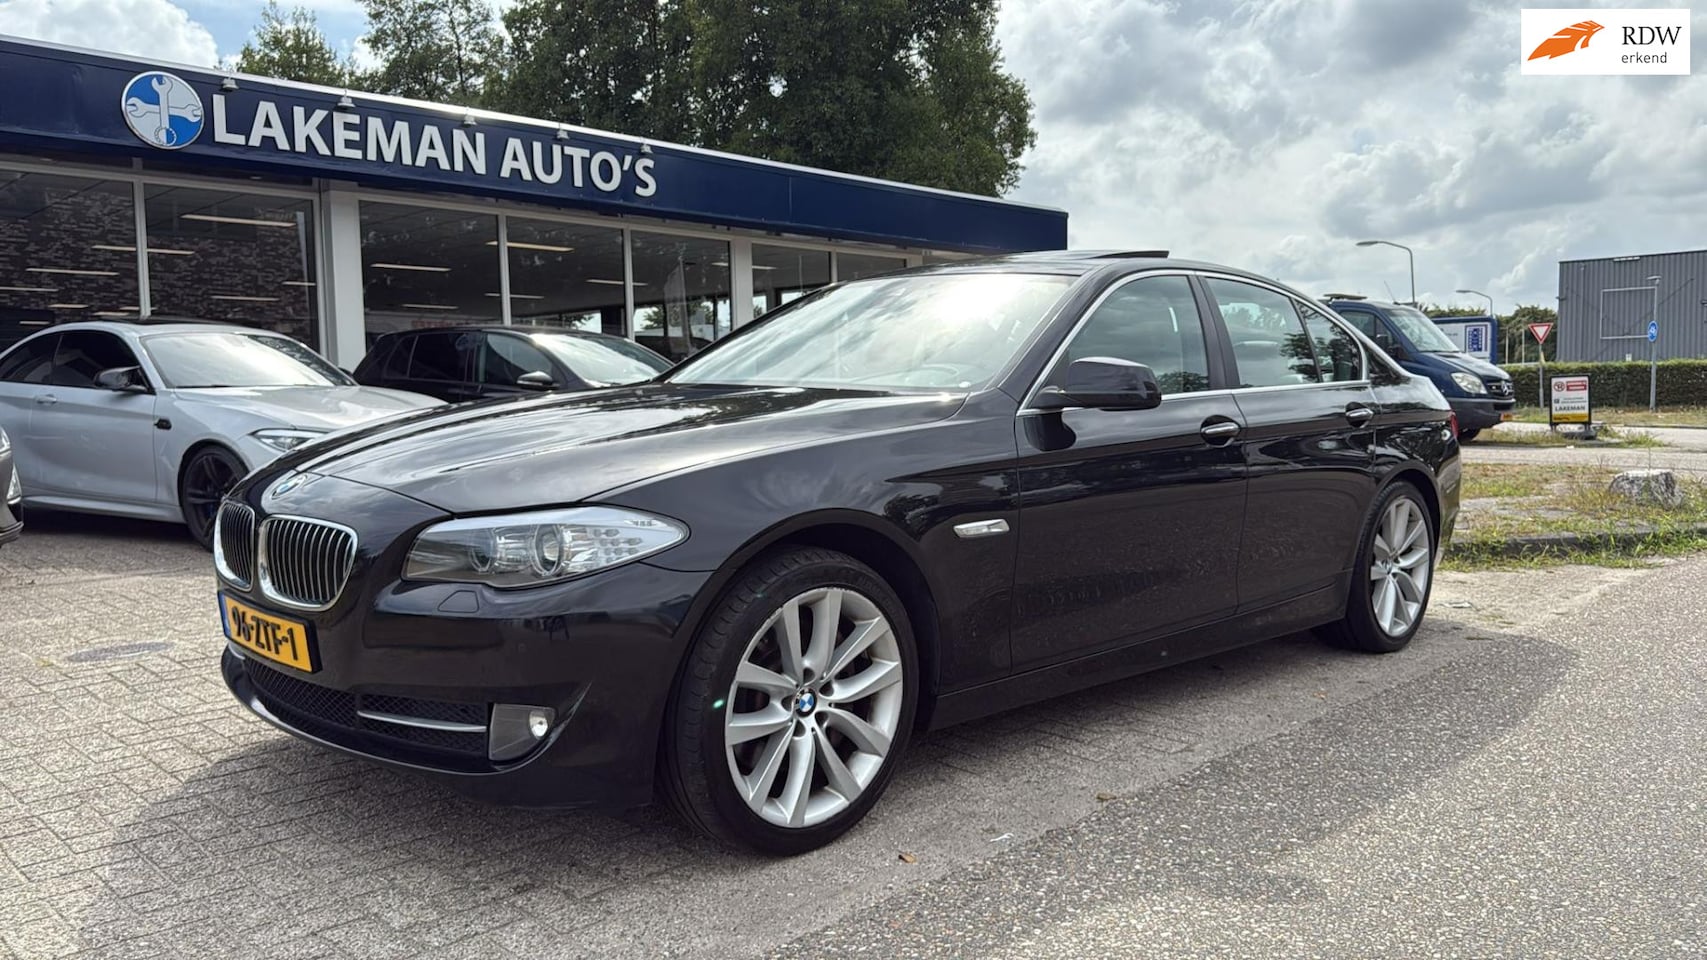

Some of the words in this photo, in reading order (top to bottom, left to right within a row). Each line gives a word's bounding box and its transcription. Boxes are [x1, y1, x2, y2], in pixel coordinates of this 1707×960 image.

[213, 94, 486, 174] LAKEMAN
[500, 137, 657, 197] AUTO'S
[232, 606, 298, 661] 96-ZTF-1
